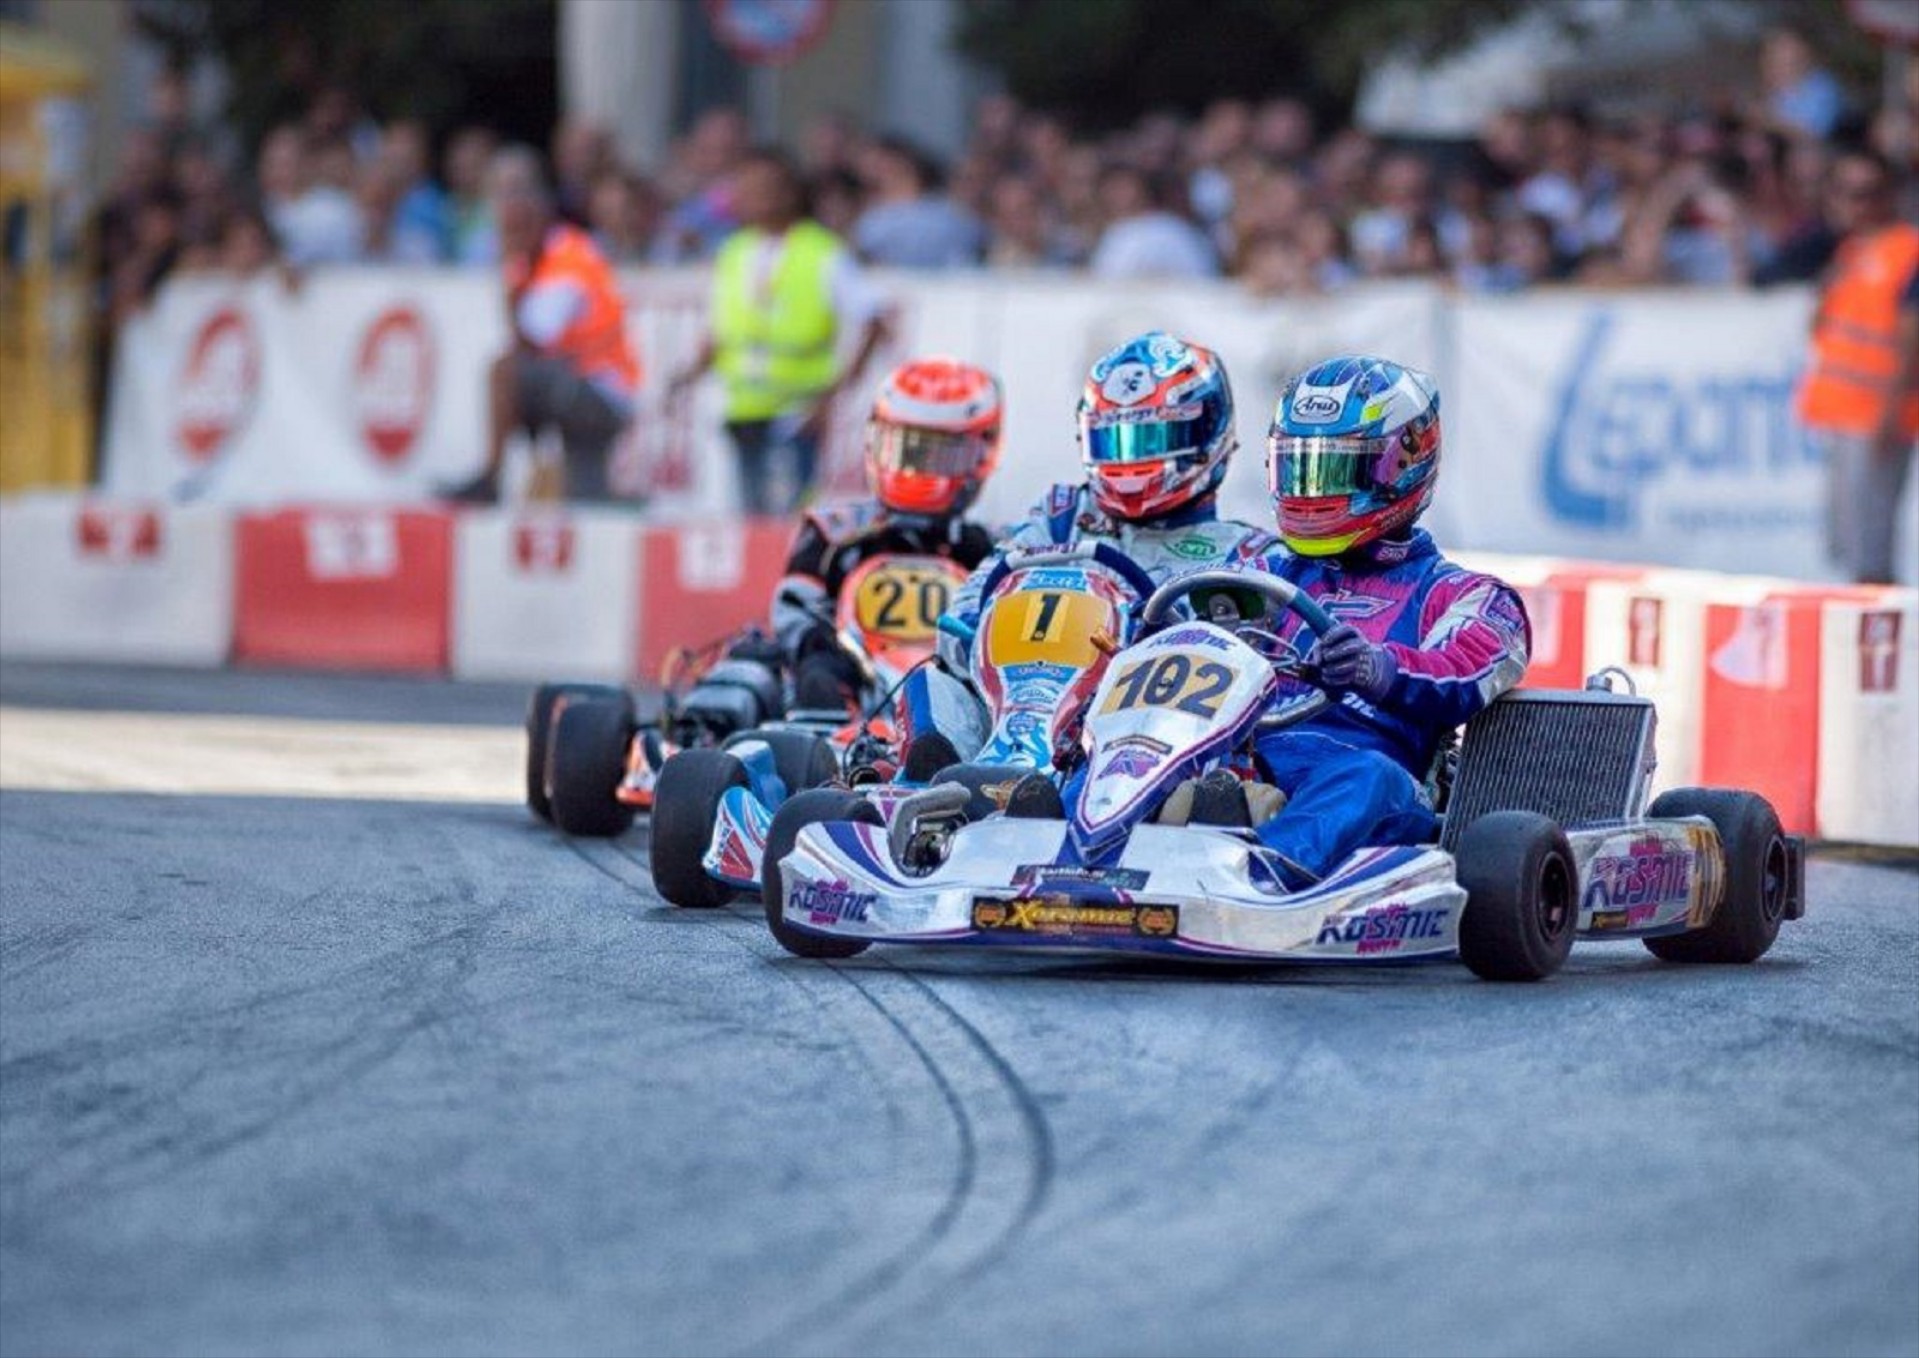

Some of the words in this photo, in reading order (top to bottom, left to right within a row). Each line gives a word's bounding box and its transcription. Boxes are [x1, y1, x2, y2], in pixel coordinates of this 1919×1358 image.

[1298, 397, 1336, 413] Arai
[873, 579, 947, 627] 20
[1029, 592, 1062, 641] 1
[1115, 654, 1234, 719] 102
[1316, 909, 1448, 944] KOSMIC
